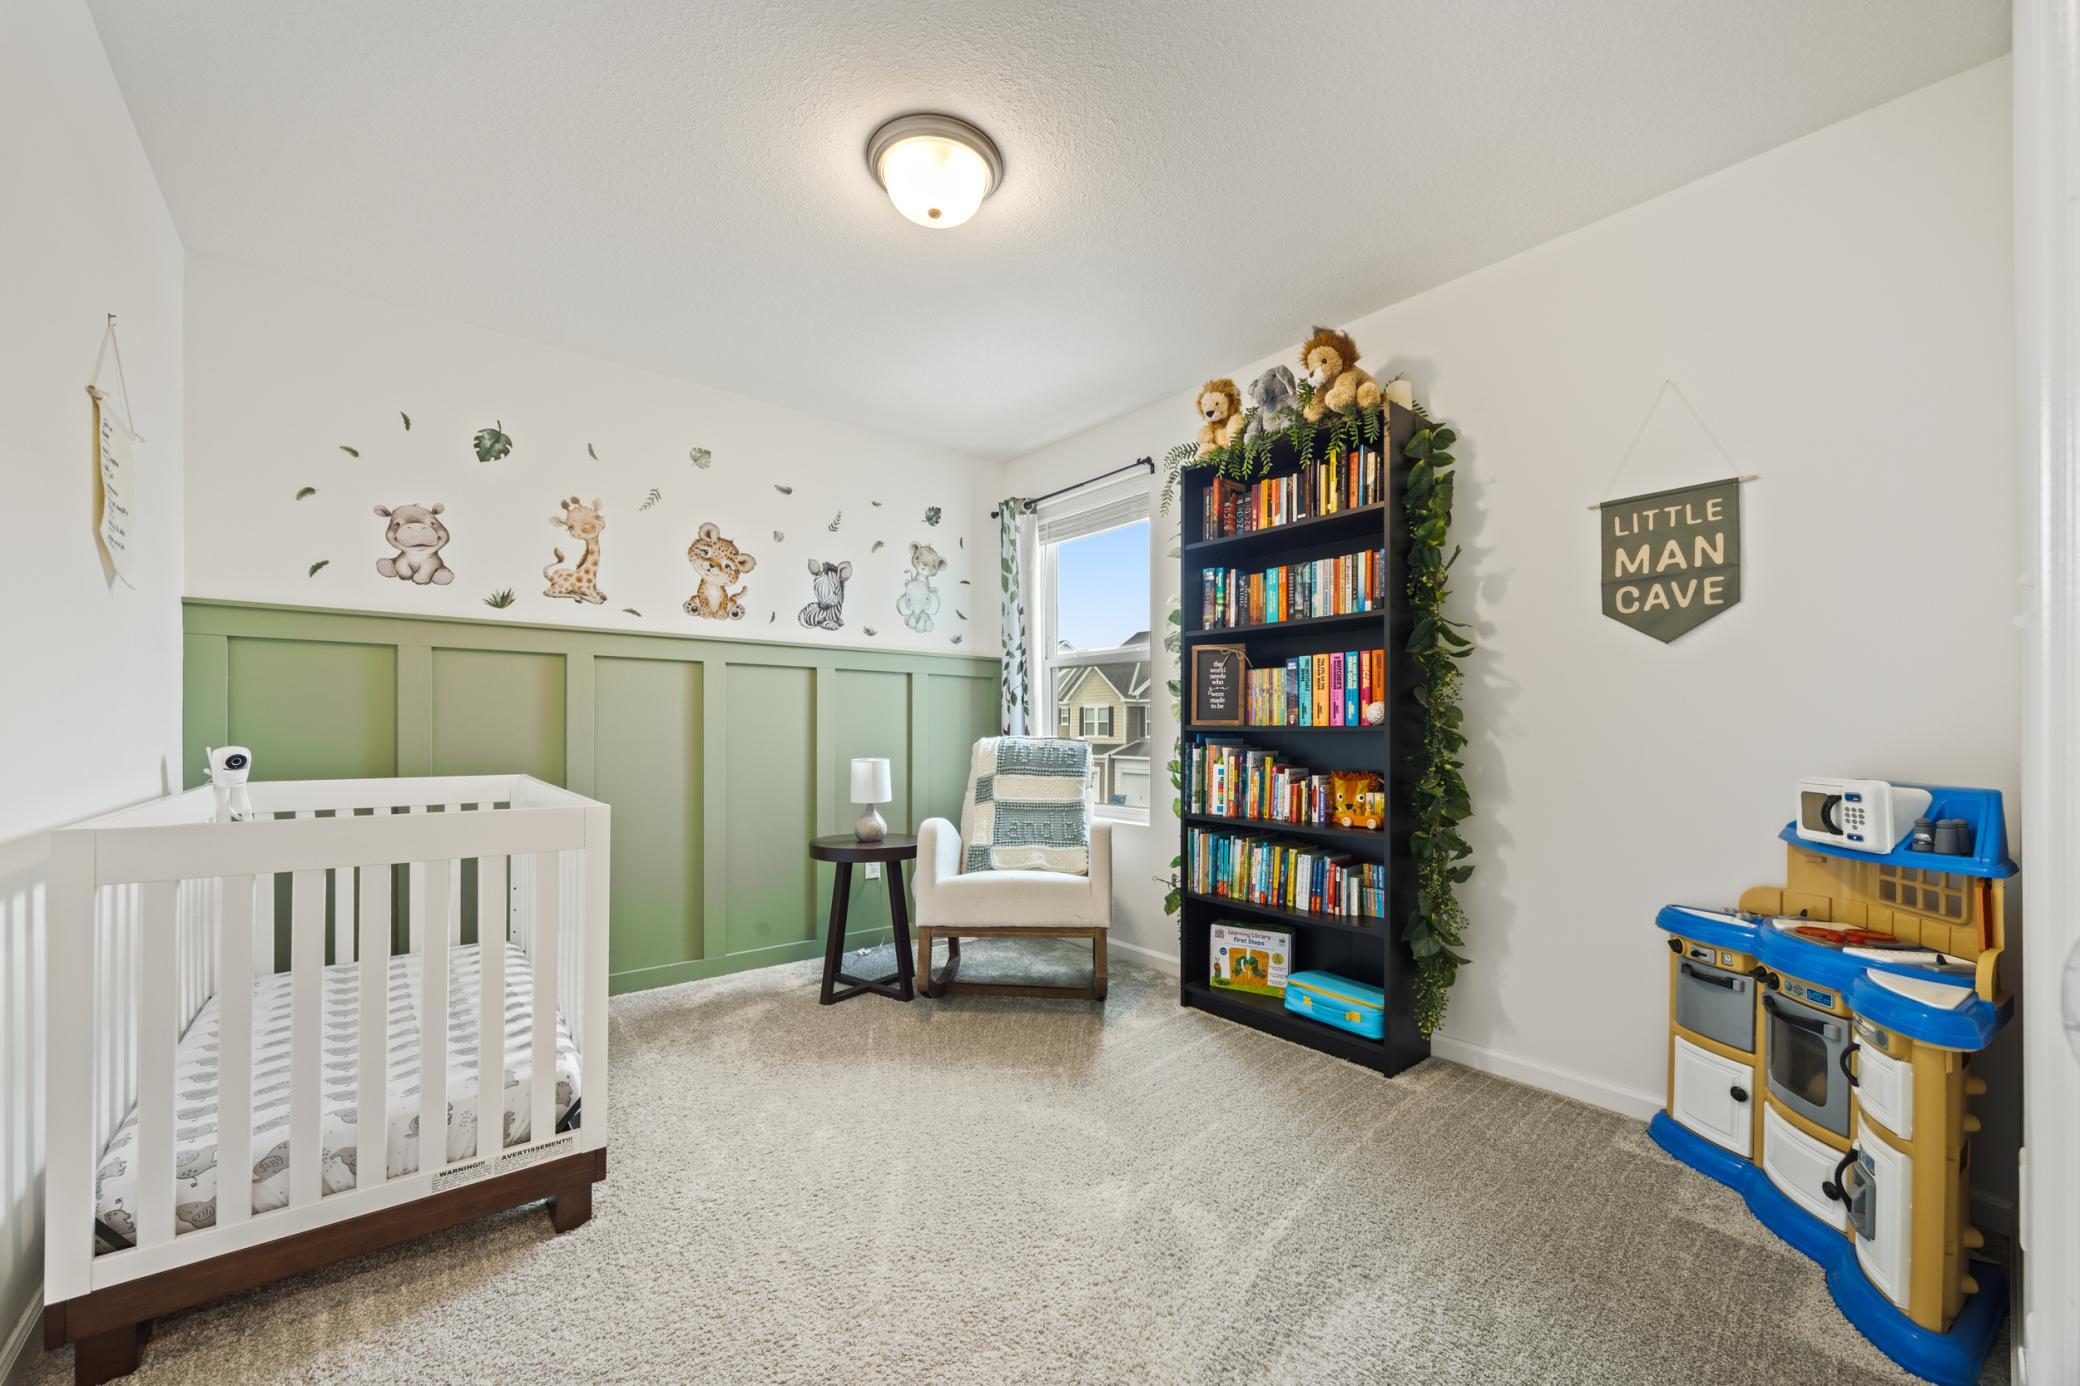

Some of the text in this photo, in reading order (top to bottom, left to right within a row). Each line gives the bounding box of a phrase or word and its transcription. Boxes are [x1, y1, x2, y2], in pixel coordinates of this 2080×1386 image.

[1614, 498, 1723, 537] LITTLE
[1614, 532, 1724, 578] MAN
[1615, 576, 1725, 614] CAVE
[1007, 811, 1055, 838] and
[1228, 929, 1250, 938] Learning
[1251, 932, 1271, 940] Library
[1248, 938, 1265, 946] Steps
[501, 1137, 573, 1161] AVERTISSEMENT!!!
[439, 1160, 486, 1178] WARNING!!!
